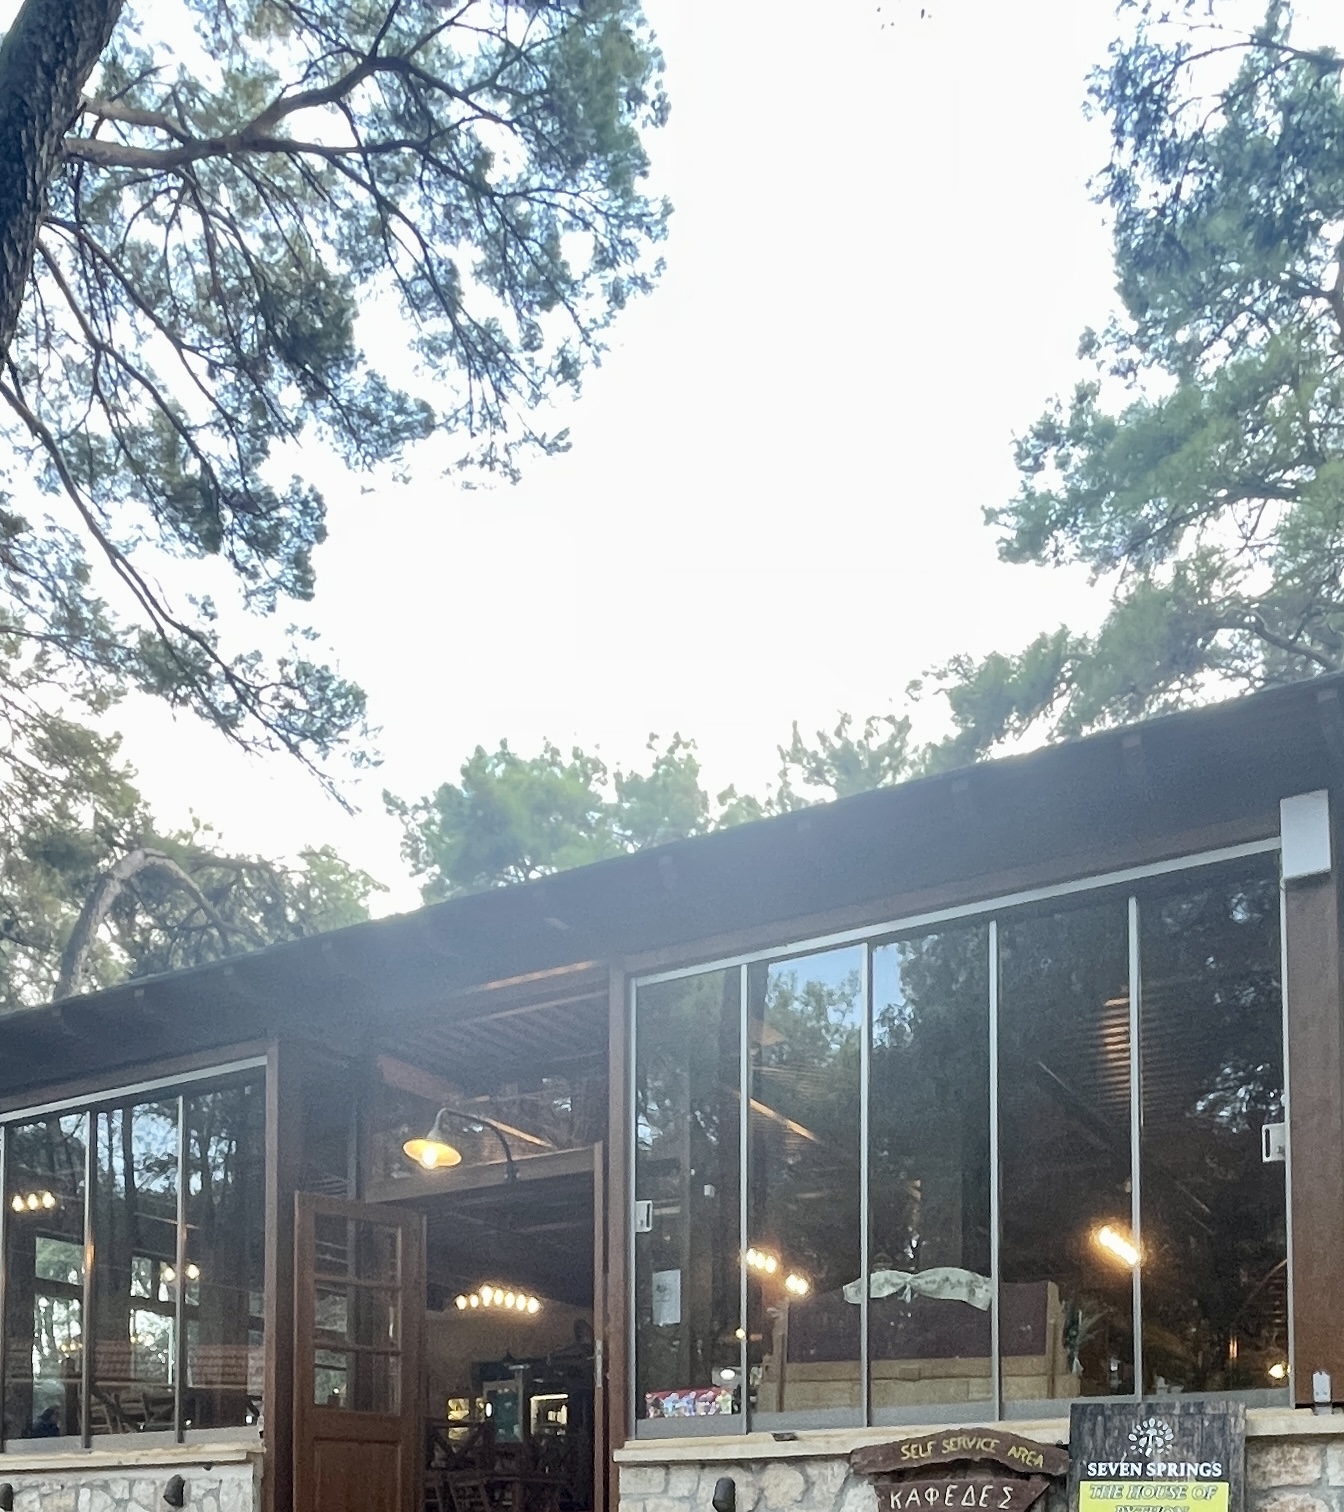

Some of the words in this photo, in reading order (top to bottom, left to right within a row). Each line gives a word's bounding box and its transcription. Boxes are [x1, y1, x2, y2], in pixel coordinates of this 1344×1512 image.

[900, 1440, 938, 1461] SELF
[941, 1435, 1000, 1454] SERVICE
[1007, 1446, 1045, 1469] AREA
[1087, 1462, 1142, 1477] SEVEN
[1146, 1462, 1222, 1477] SPRINGS
[889, 1483, 1015, 1510] ΚΑΦΕΔΕΣ
[1090, 1484, 1124, 1500] THE
[1126, 1484, 1188, 1500] HOUSE
[1191, 1485, 1218, 1501] OF
